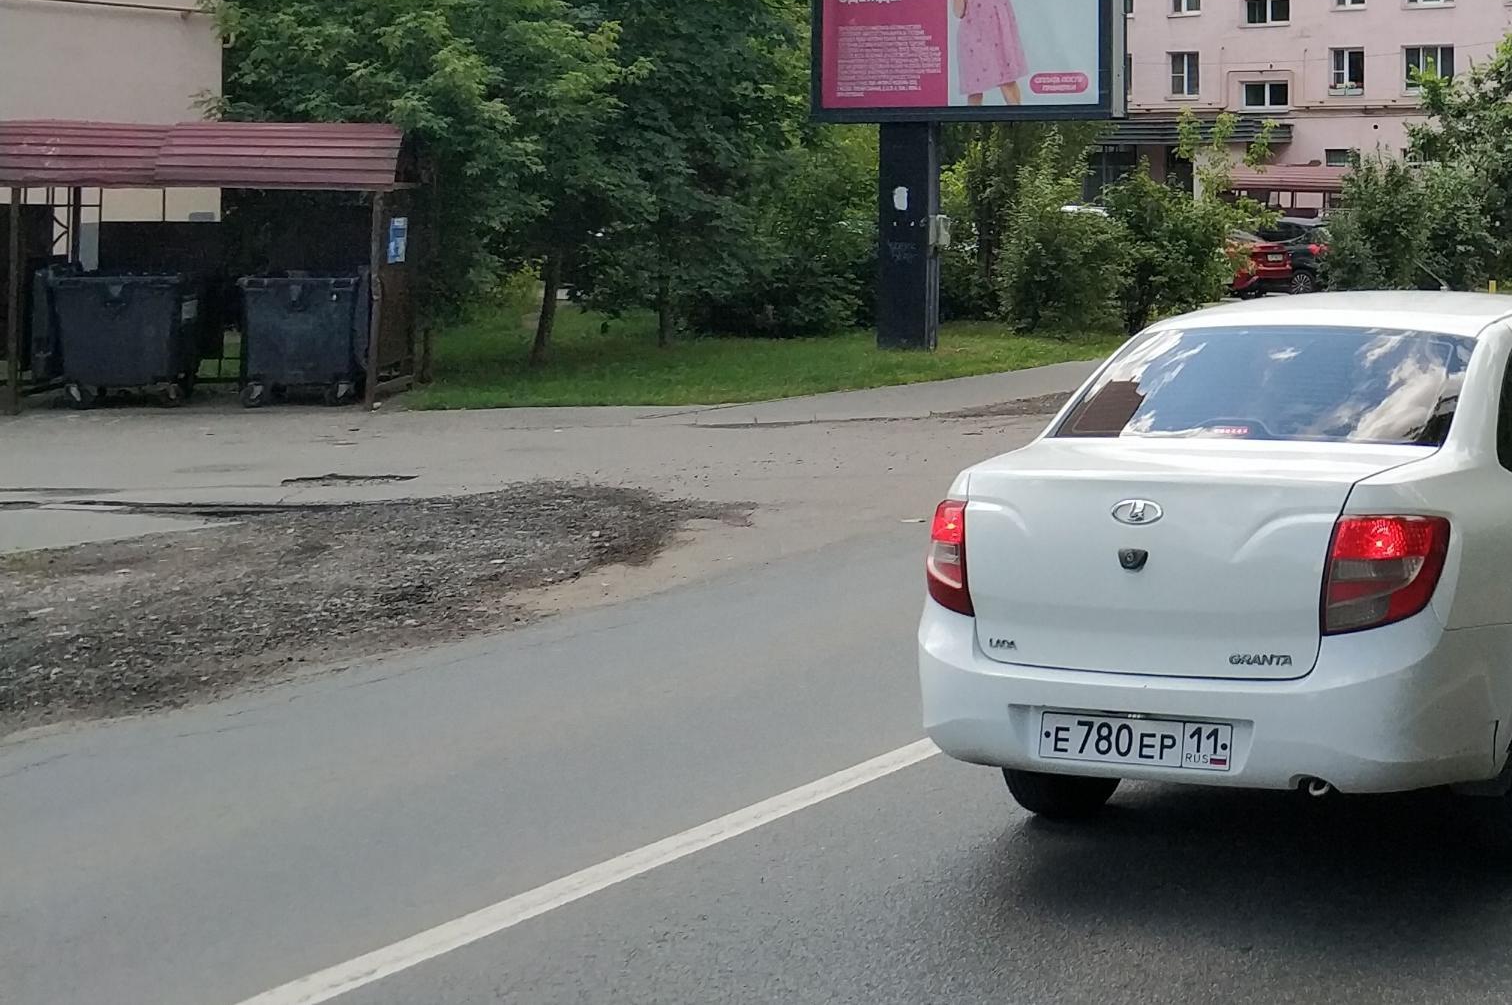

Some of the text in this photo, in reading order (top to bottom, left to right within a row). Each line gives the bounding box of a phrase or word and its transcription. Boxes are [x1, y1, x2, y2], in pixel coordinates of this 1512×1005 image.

[989, 638, 1017, 650] LADA
[1229, 654, 1292, 666] GRANTA
[1189, 727, 1219, 755] 11
[1185, 753, 1209, 764] RUS
